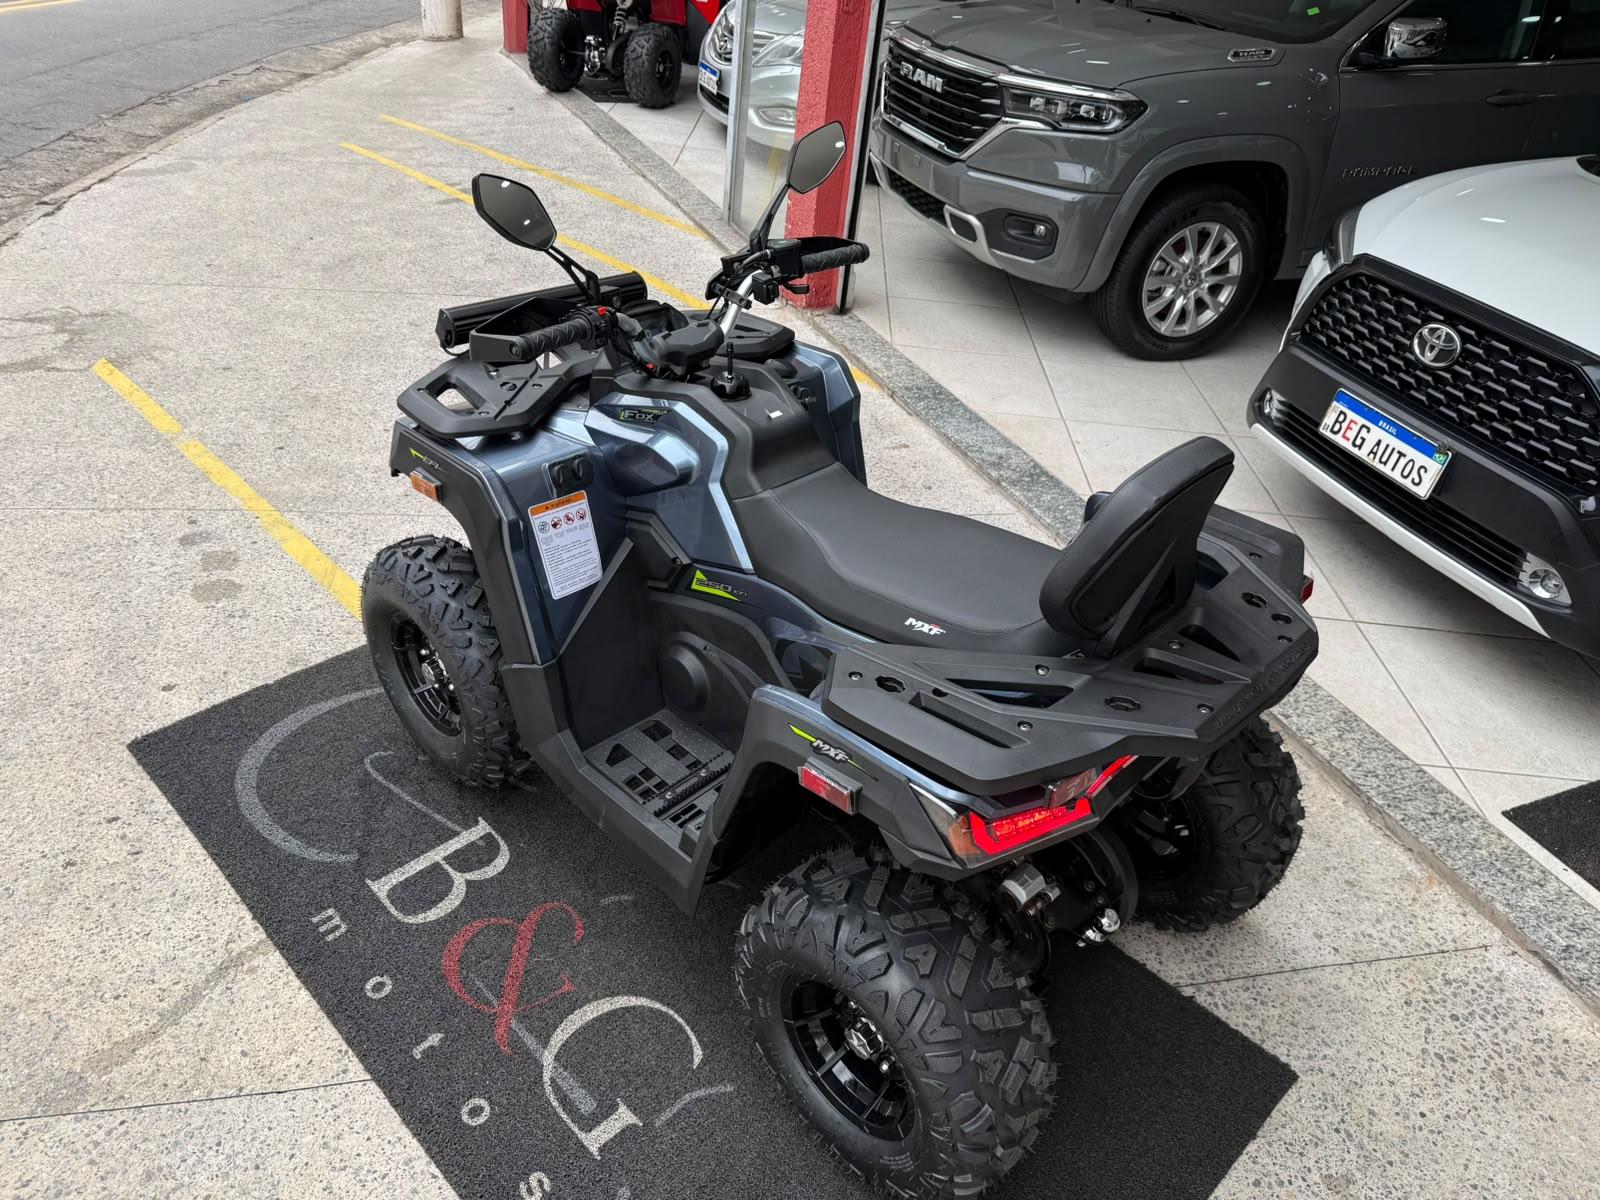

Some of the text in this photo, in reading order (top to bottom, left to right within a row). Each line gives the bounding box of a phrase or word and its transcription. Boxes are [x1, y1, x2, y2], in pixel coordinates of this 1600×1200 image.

[900, 61, 943, 93] RAM
[1378, 419, 1397, 436] BRASIL
[1329, 409, 1428, 487] BEG AUTOS
[904, 617, 947, 636] MXF
[812, 739, 849, 761] MXF
